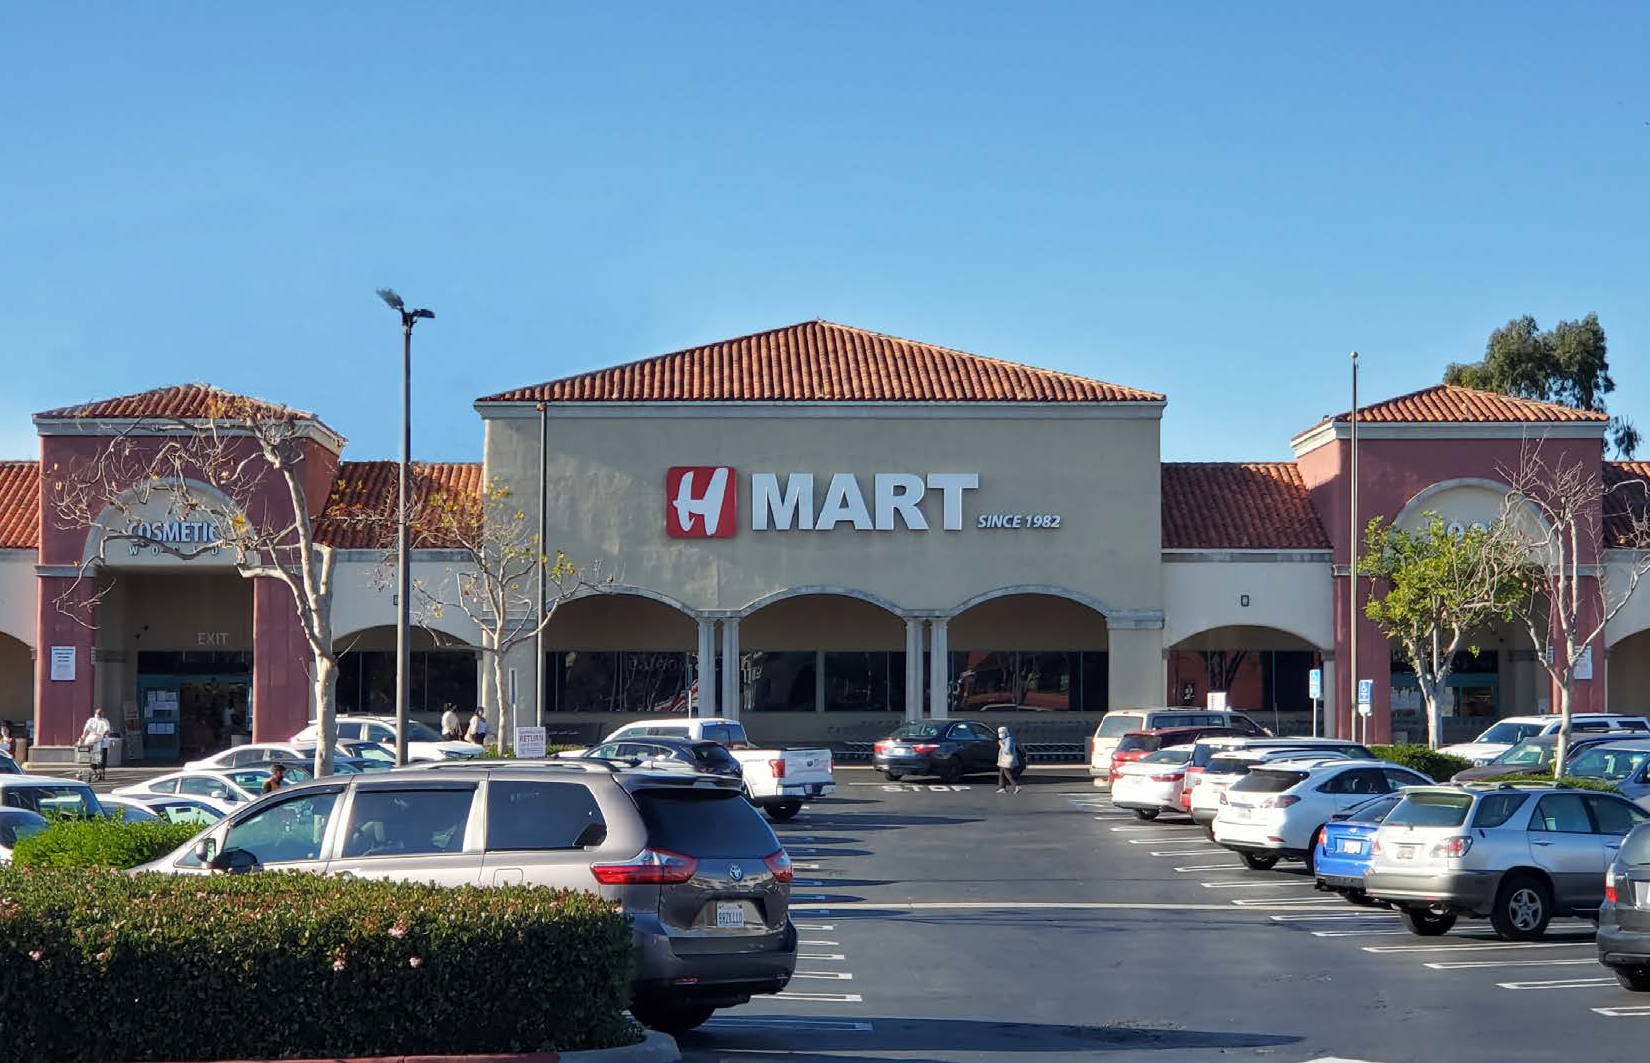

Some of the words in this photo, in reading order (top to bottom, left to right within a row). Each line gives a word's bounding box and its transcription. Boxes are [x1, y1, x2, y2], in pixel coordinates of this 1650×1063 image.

[673, 467, 729, 536] H
[752, 473, 979, 530] MART
[977, 514, 1021, 528] SINCE
[1026, 514, 1061, 528] 1982
[196, 632, 230, 645] EXIT
